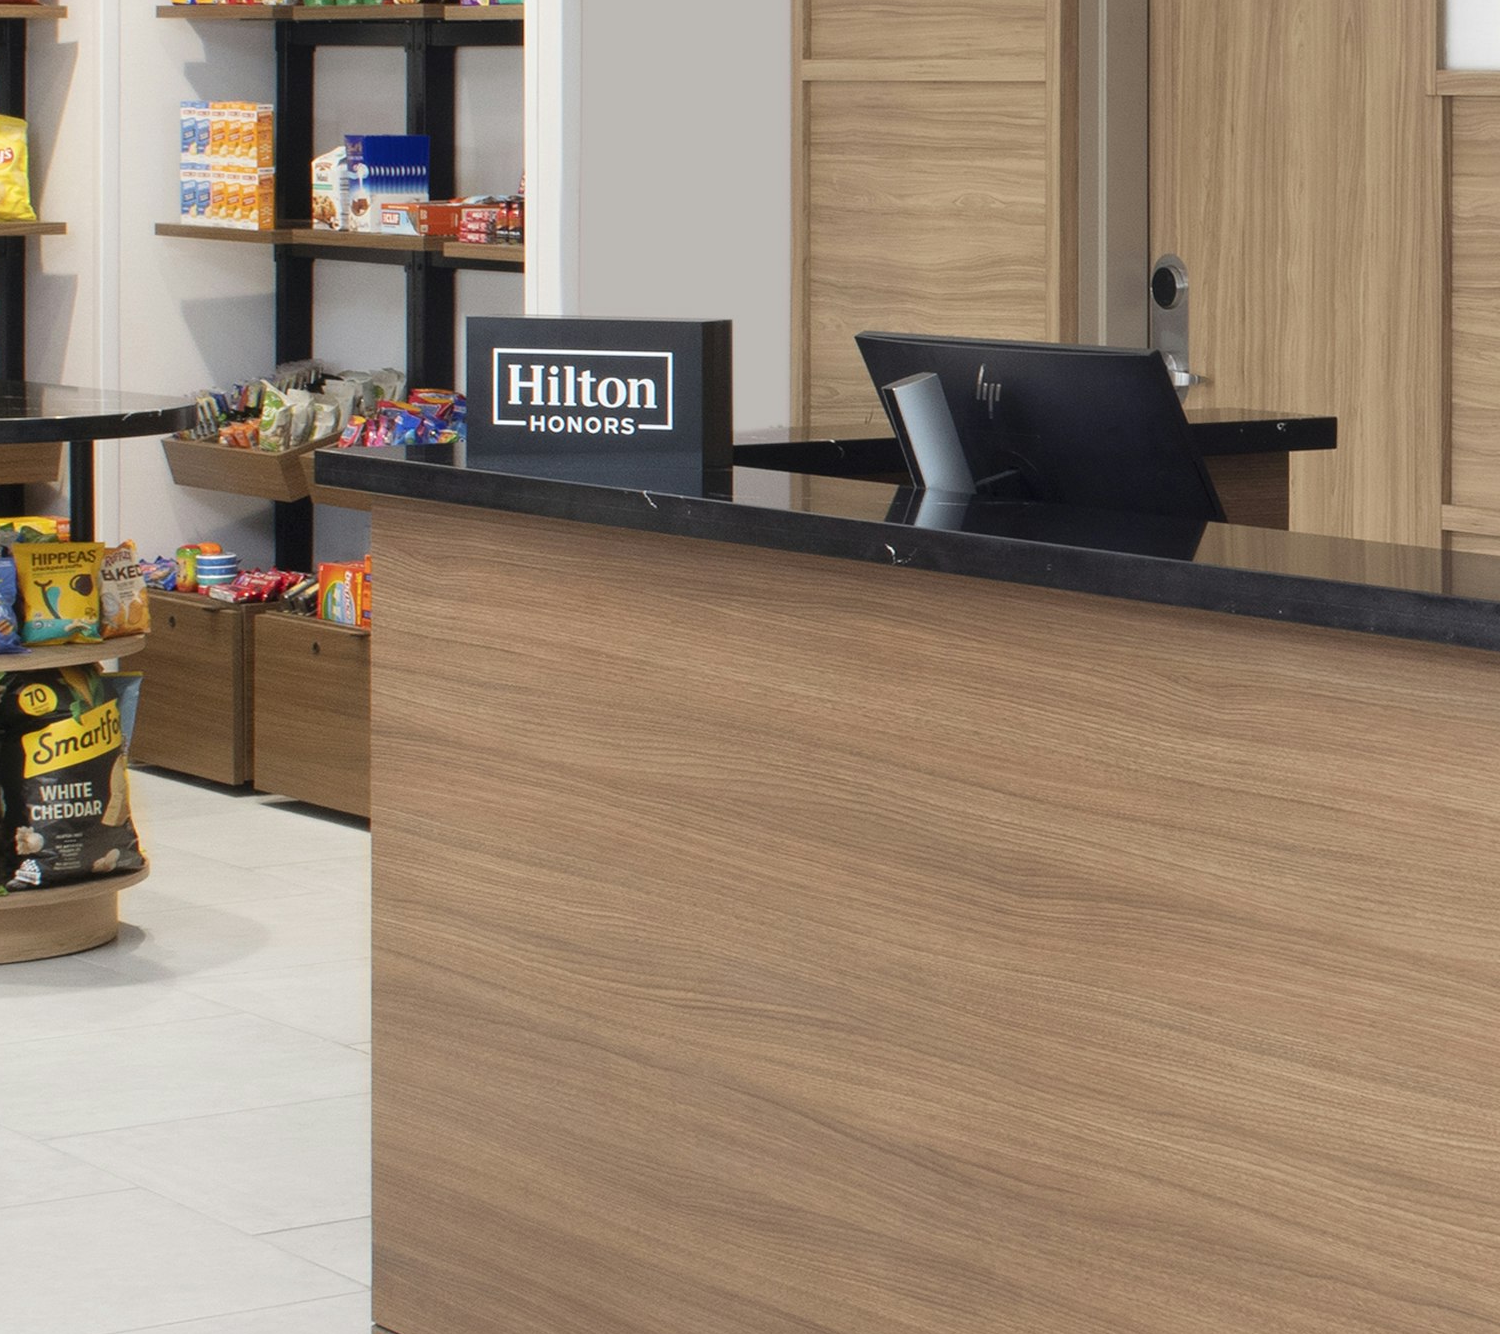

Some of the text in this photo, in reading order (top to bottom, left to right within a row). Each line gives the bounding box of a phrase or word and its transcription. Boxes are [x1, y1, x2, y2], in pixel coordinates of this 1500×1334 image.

[508, 364, 657, 409] Hilton
[530, 415, 635, 435] HONORS
[31, 549, 97, 567] HIPPEAS
[24, 688, 47, 706] 70
[33, 709, 120, 765] Smartfo
[40, 782, 93, 802] WHITE
[31, 800, 103, 821] CHEDDAR
